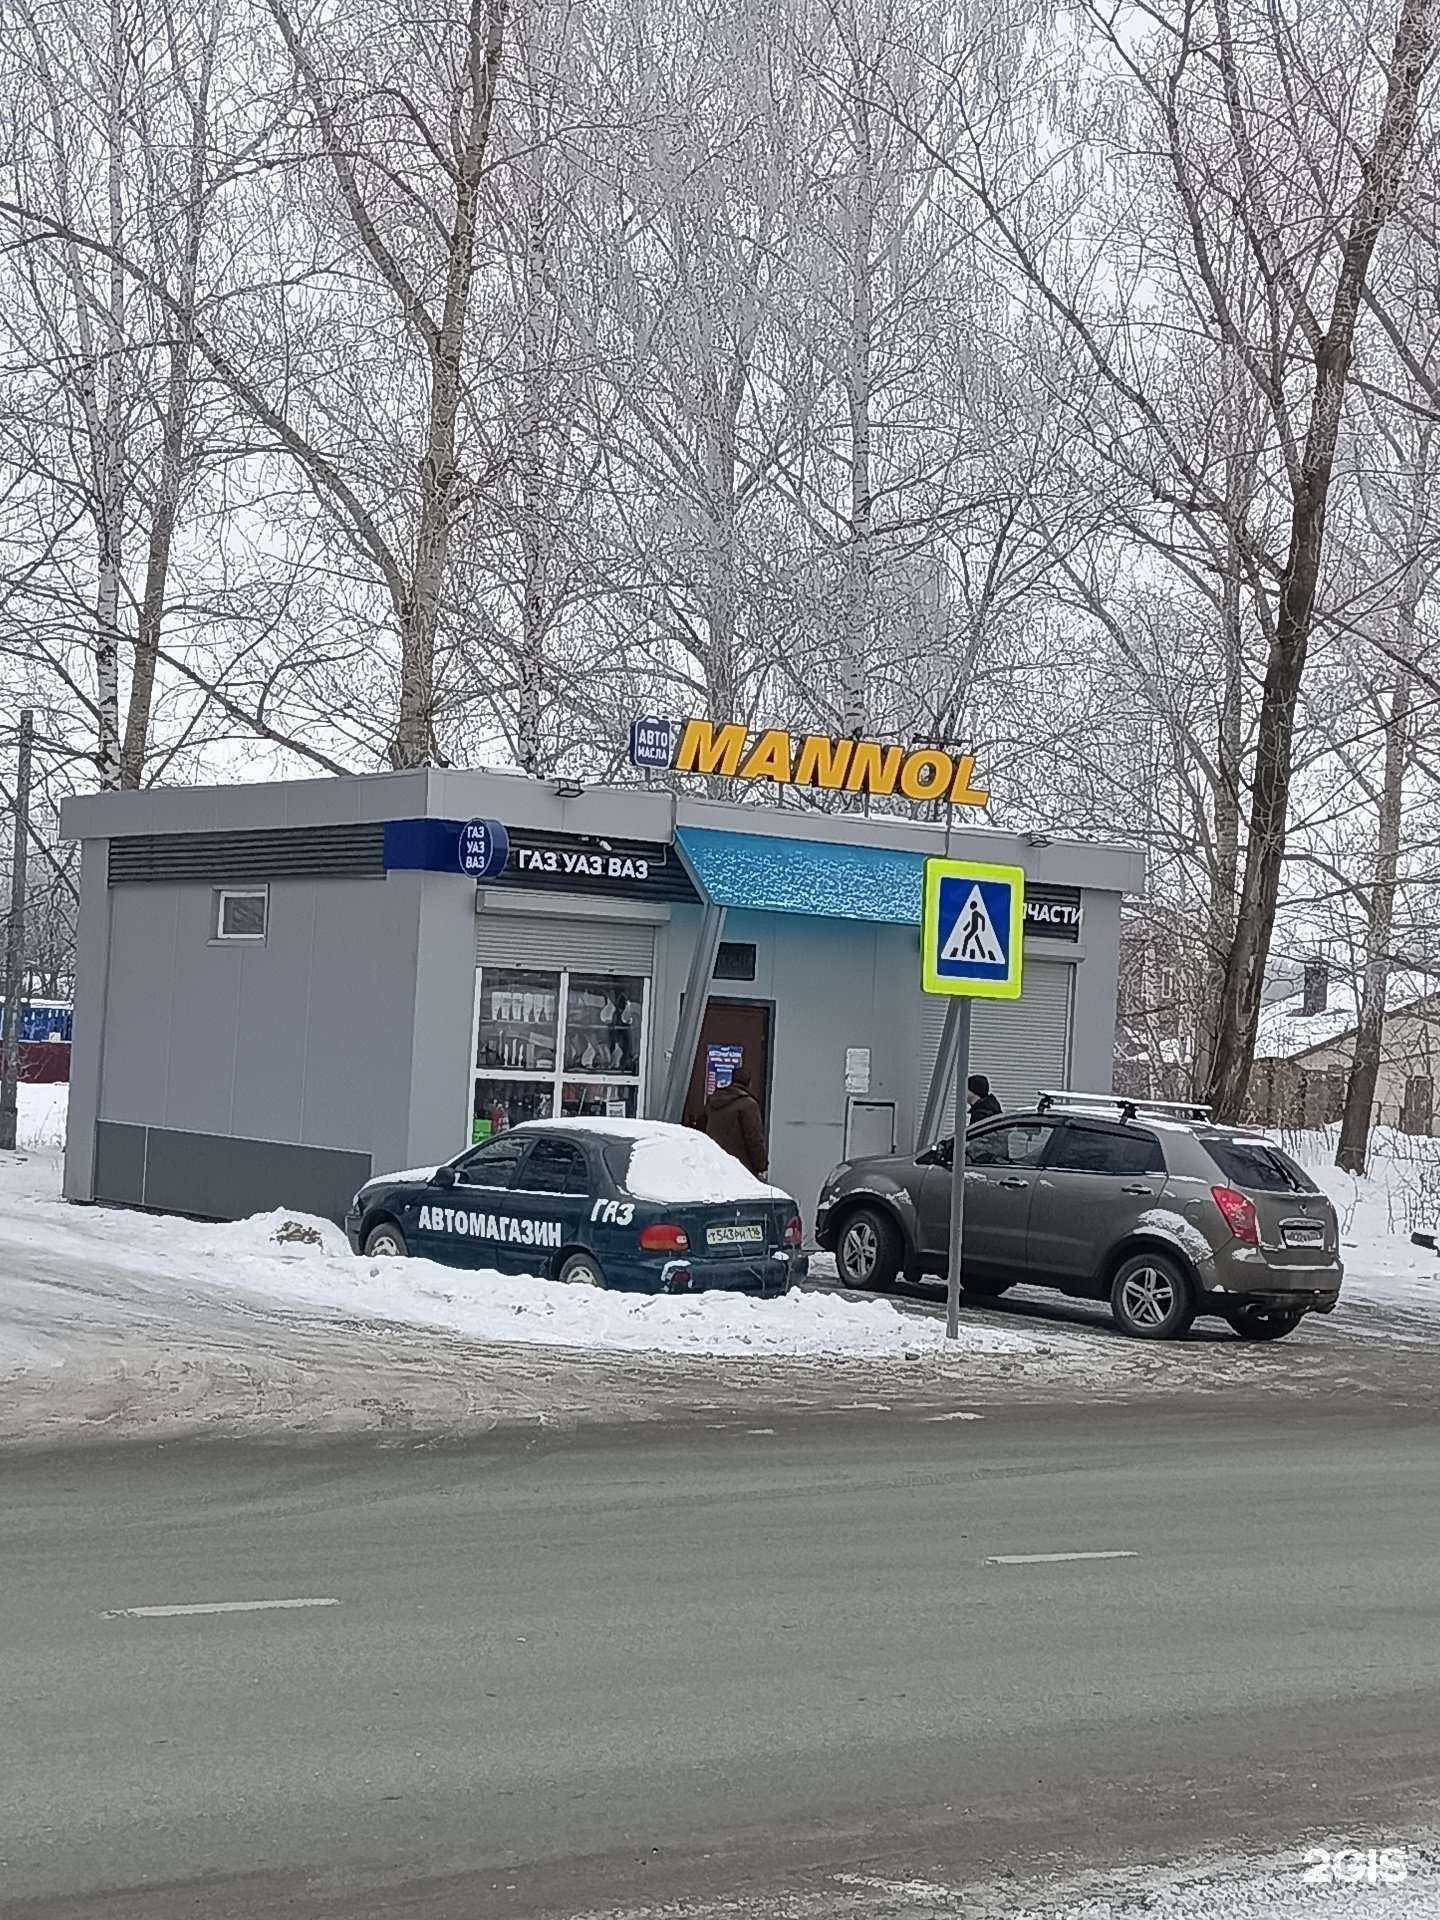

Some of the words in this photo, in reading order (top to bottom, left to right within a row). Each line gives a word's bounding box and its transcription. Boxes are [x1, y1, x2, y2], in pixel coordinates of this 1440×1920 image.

[639, 729, 668, 747] АВТО
[638, 745, 667, 760] МАСЛА
[675, 718, 991, 807] MANNOL
[467, 826, 485, 839] ГАЗ
[466, 841, 485, 854] УАЗ
[465, 856, 485, 869] ВАЗ
[518, 850, 556, 871] ГАЗ
[560, 853, 603, 874] УАЗ
[607, 857, 649, 879] ВАЗ
[590, 1198, 635, 1226] ГАЗ
[418, 1205, 562, 1247] АВТОМАГАЗИН
